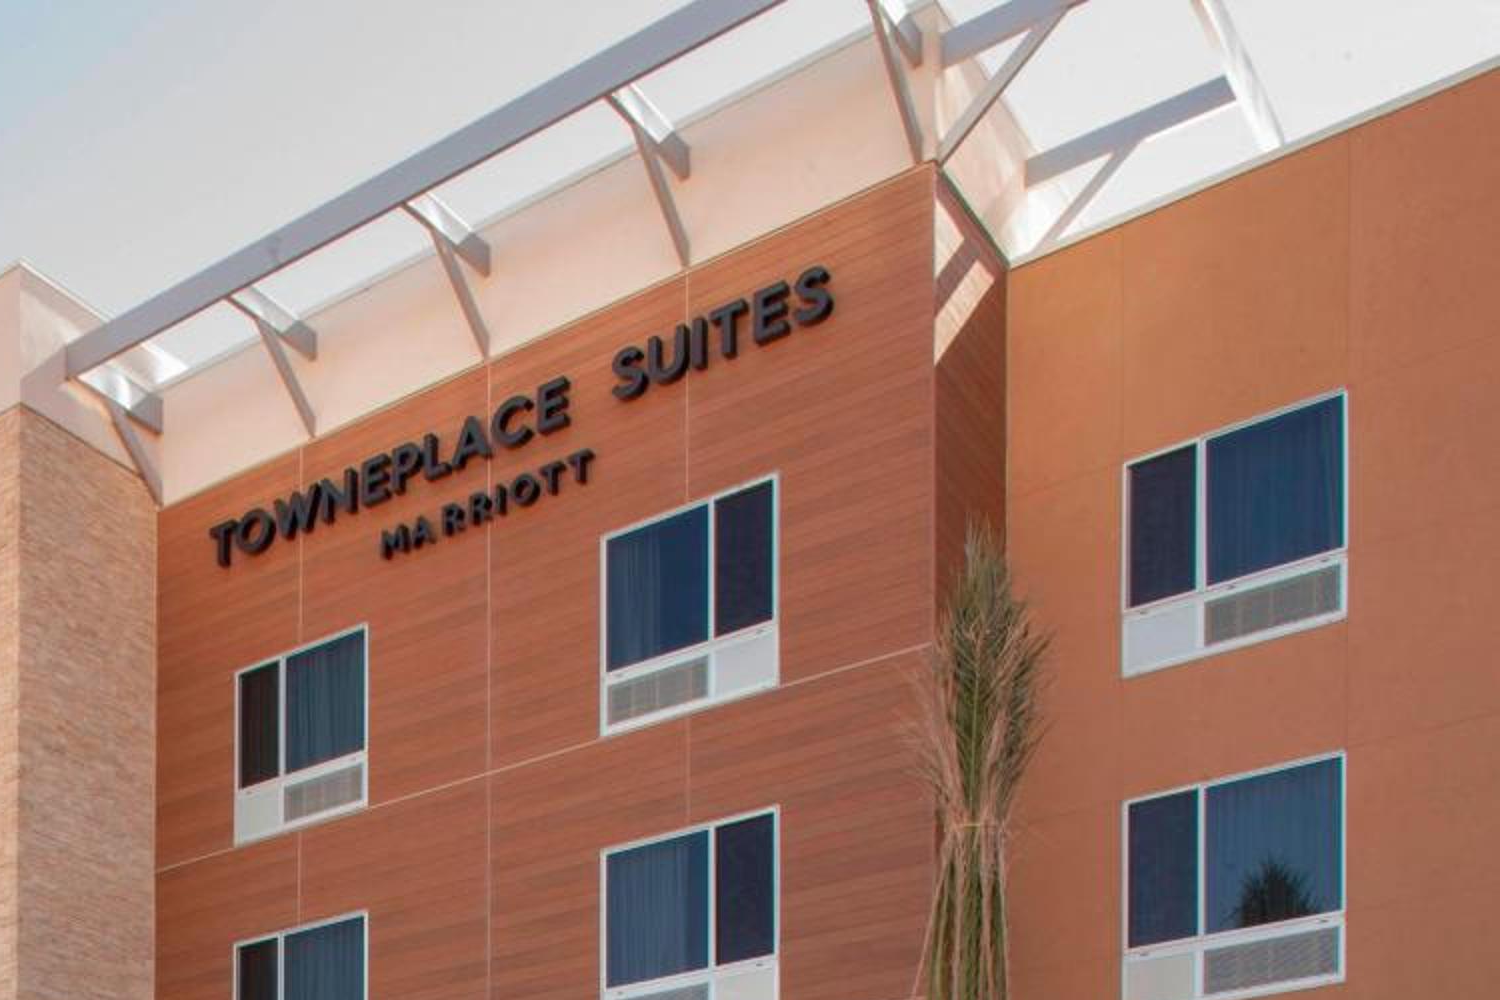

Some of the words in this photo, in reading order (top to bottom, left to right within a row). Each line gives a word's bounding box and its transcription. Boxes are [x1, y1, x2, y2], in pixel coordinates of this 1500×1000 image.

[209, 376, 573, 568] TOWNEPLACE
[611, 265, 834, 402] SUITES
[379, 449, 597, 559] MARRIOTT
